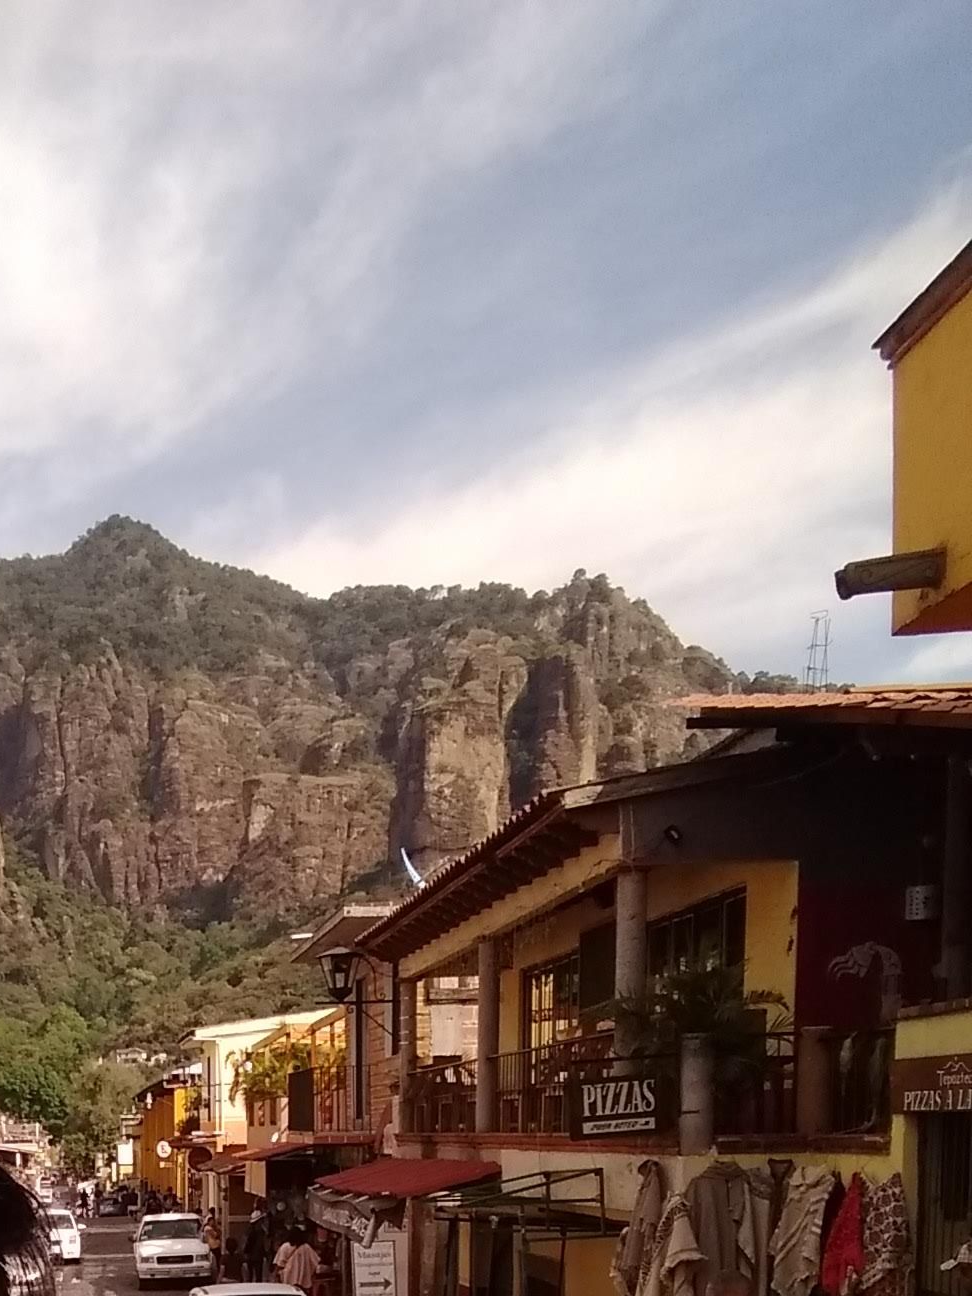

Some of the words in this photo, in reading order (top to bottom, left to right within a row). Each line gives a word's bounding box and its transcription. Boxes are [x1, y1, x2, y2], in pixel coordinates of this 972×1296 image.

[581, 1079, 656, 1117] PIZZAS
[903, 1090, 942, 1112] PIZZAS
[942, 1089, 953, 1111] A
